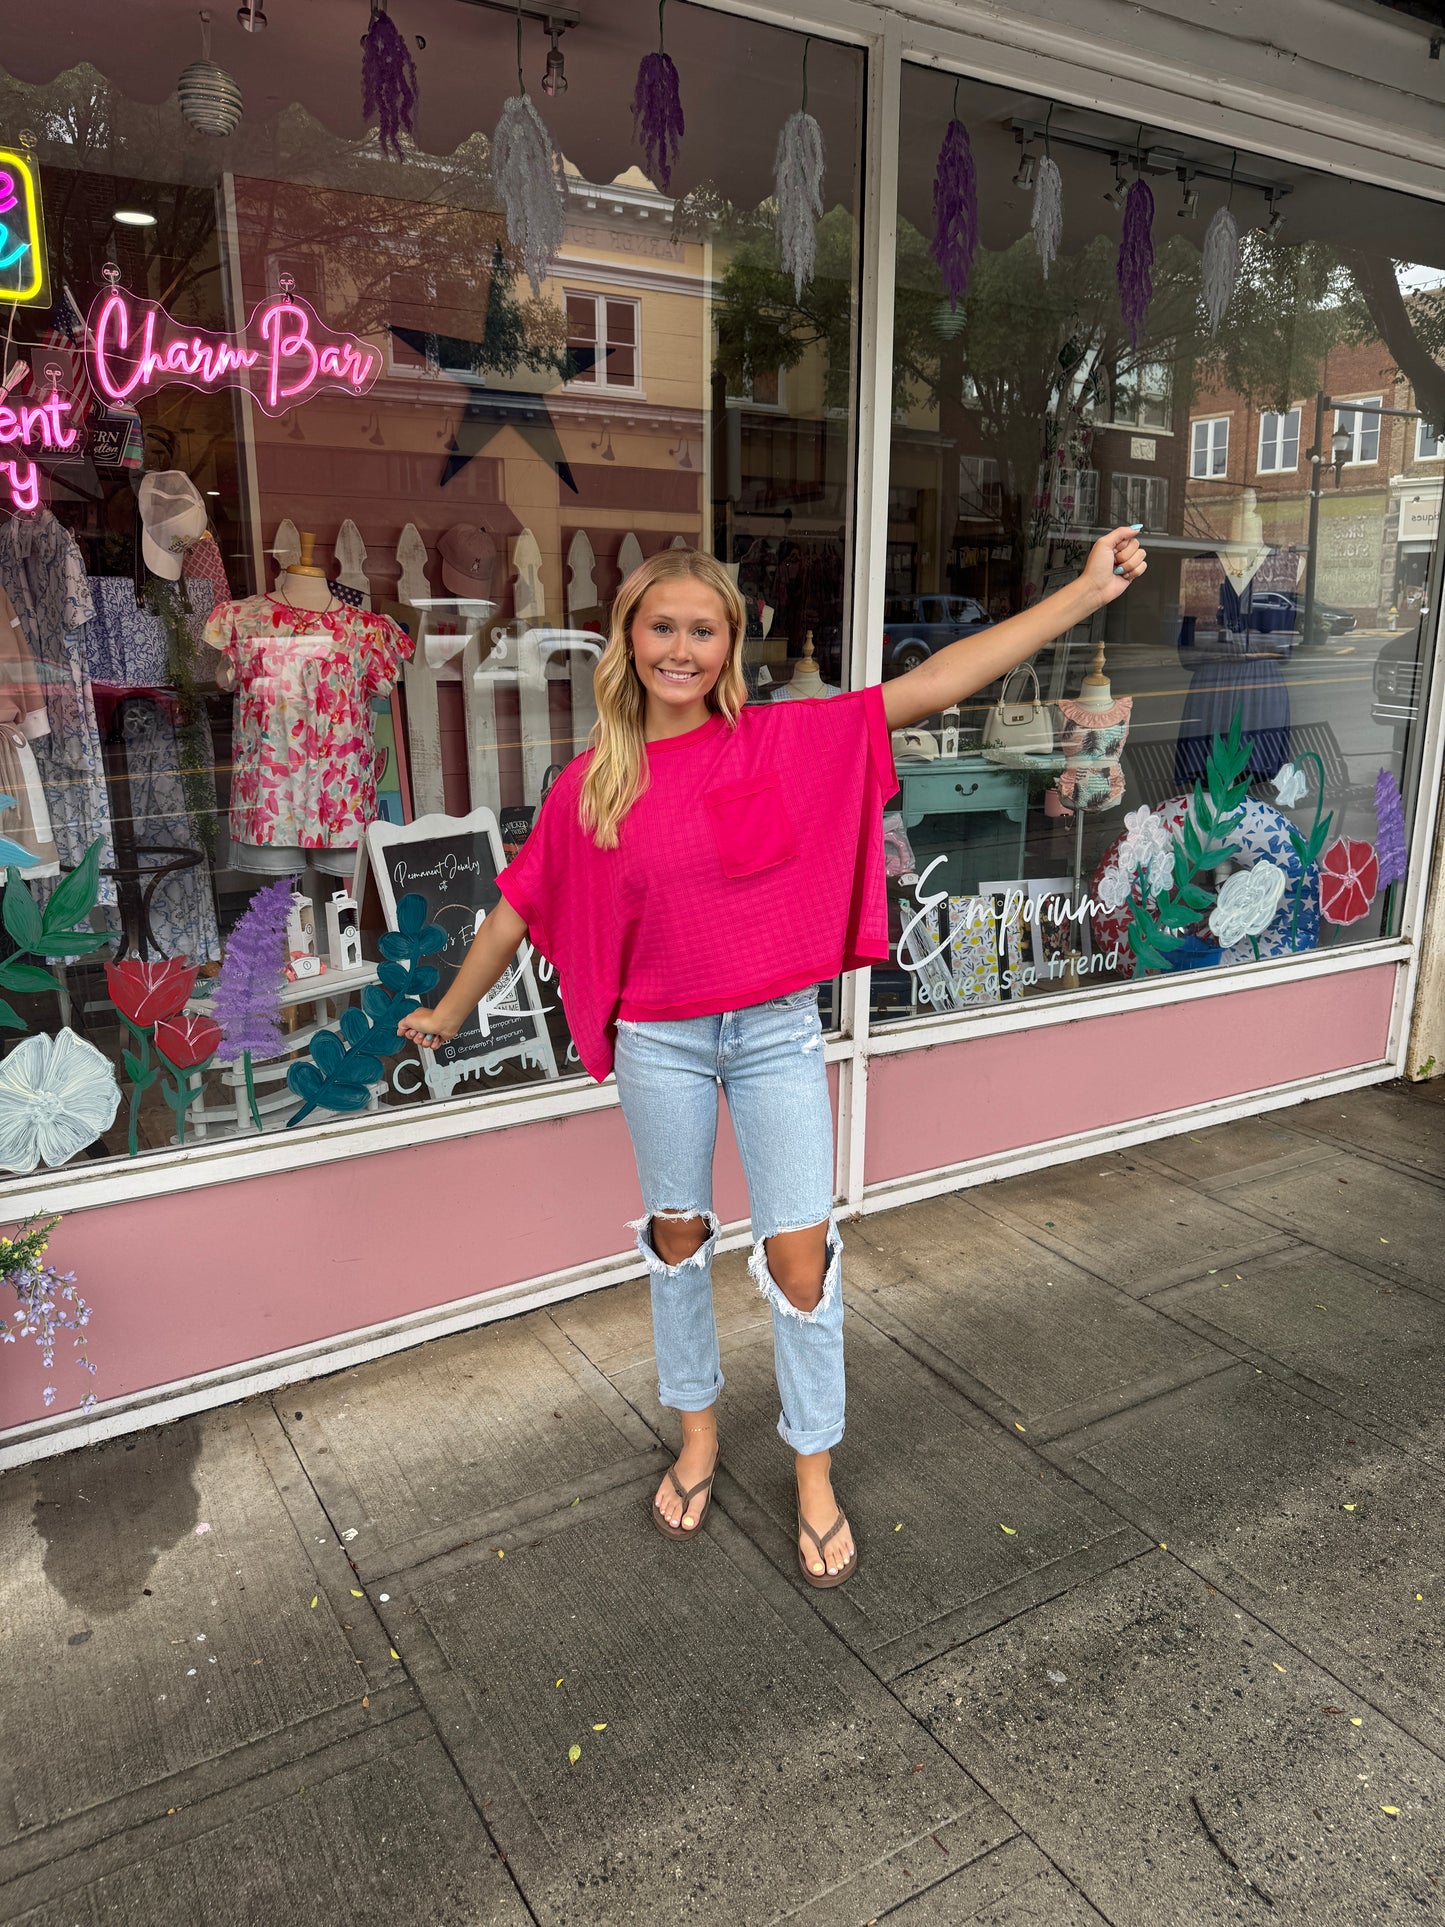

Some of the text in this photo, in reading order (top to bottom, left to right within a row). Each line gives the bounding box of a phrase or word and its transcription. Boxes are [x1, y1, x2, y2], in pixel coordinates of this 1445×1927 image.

[96, 295, 374, 408] Charm Bar
[393, 853, 480, 888] Permanent Jewelry
[896, 854, 1118, 972] Emporium
[985, 972, 1013, 993] as
[1022, 965, 1039, 986] a
[1048, 942, 1120, 980] friend
[392, 1052, 504, 1096] Come
